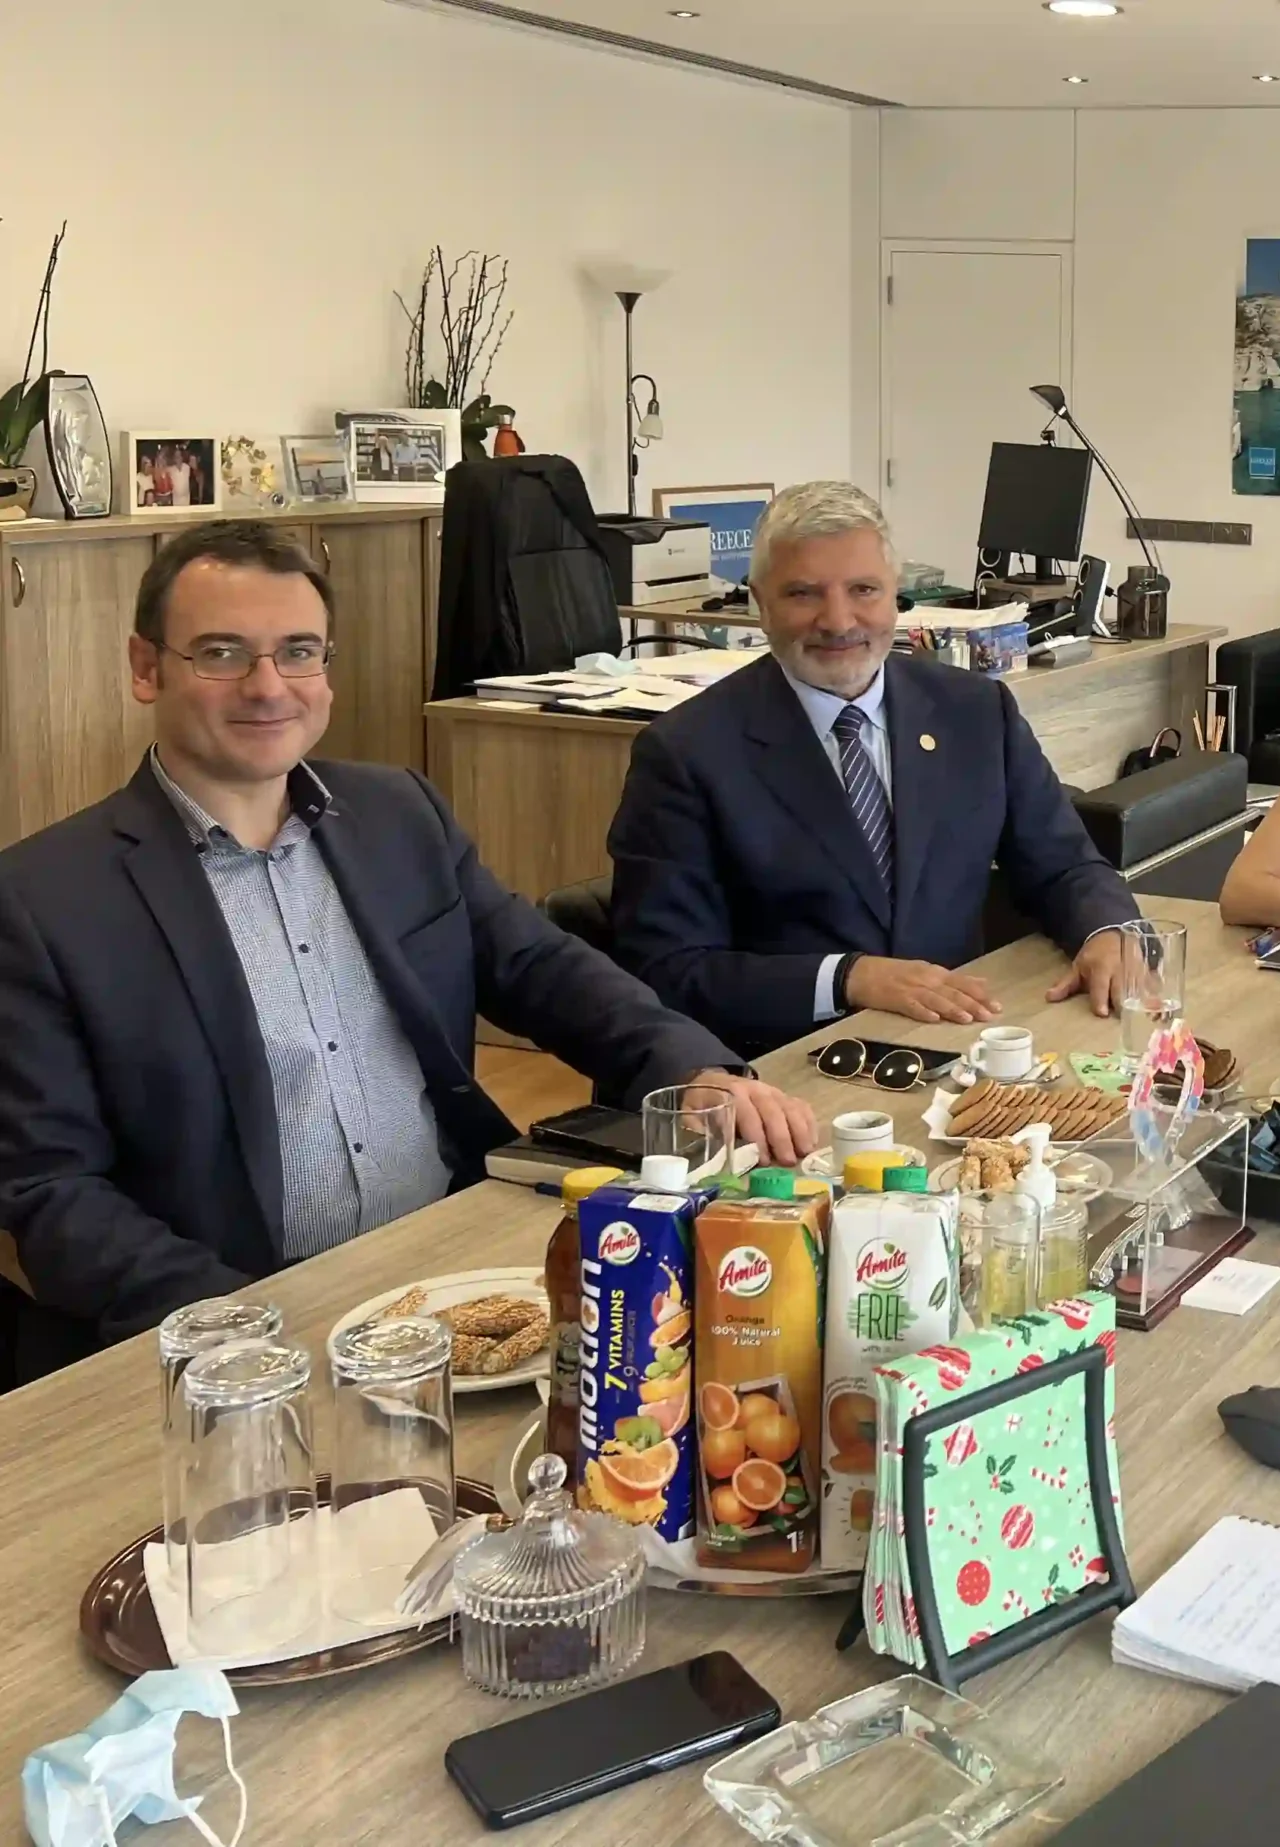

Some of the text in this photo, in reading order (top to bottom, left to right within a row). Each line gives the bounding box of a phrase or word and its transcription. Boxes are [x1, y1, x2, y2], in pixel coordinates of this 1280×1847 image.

[599, 1229, 638, 1258] Amita
[719, 1257, 768, 1290] Amita
[856, 1247, 907, 1282] Amita
[725, 1314, 765, 1325] Orange
[742, 1327, 781, 1337] Natural
[856, 1293, 906, 1341] FREE
[579, 1258, 602, 1450] motion
[604, 1289, 627, 1391] 7 VITAMINS
[731, 1338, 762, 1346] Juice
